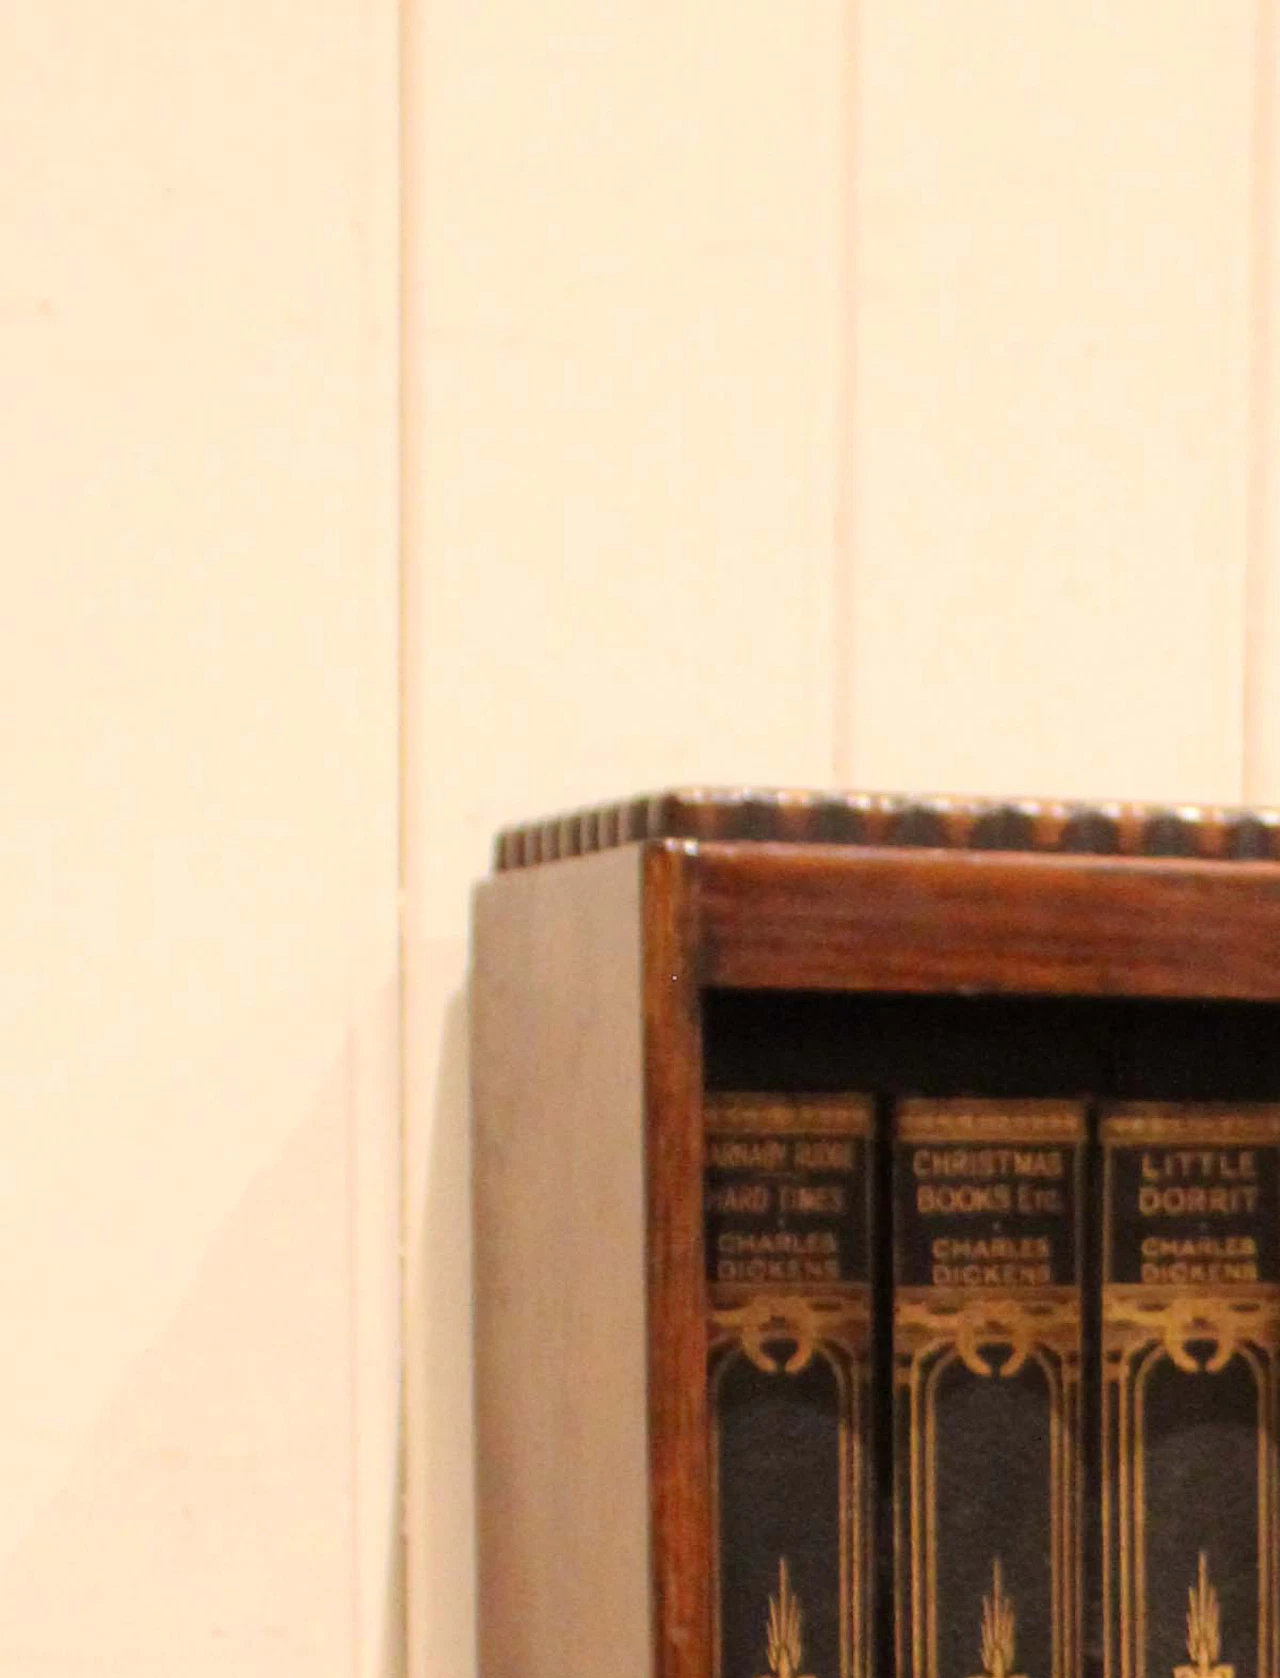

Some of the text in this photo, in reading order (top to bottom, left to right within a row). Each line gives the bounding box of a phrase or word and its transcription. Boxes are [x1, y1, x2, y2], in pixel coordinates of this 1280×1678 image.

[912, 1149, 1064, 1178] CHRISTMAS
[1141, 1150, 1256, 1178] LITTLE
[917, 1186, 1008, 1214] BOOKS
[1138, 1186, 1258, 1214] DORRIT
